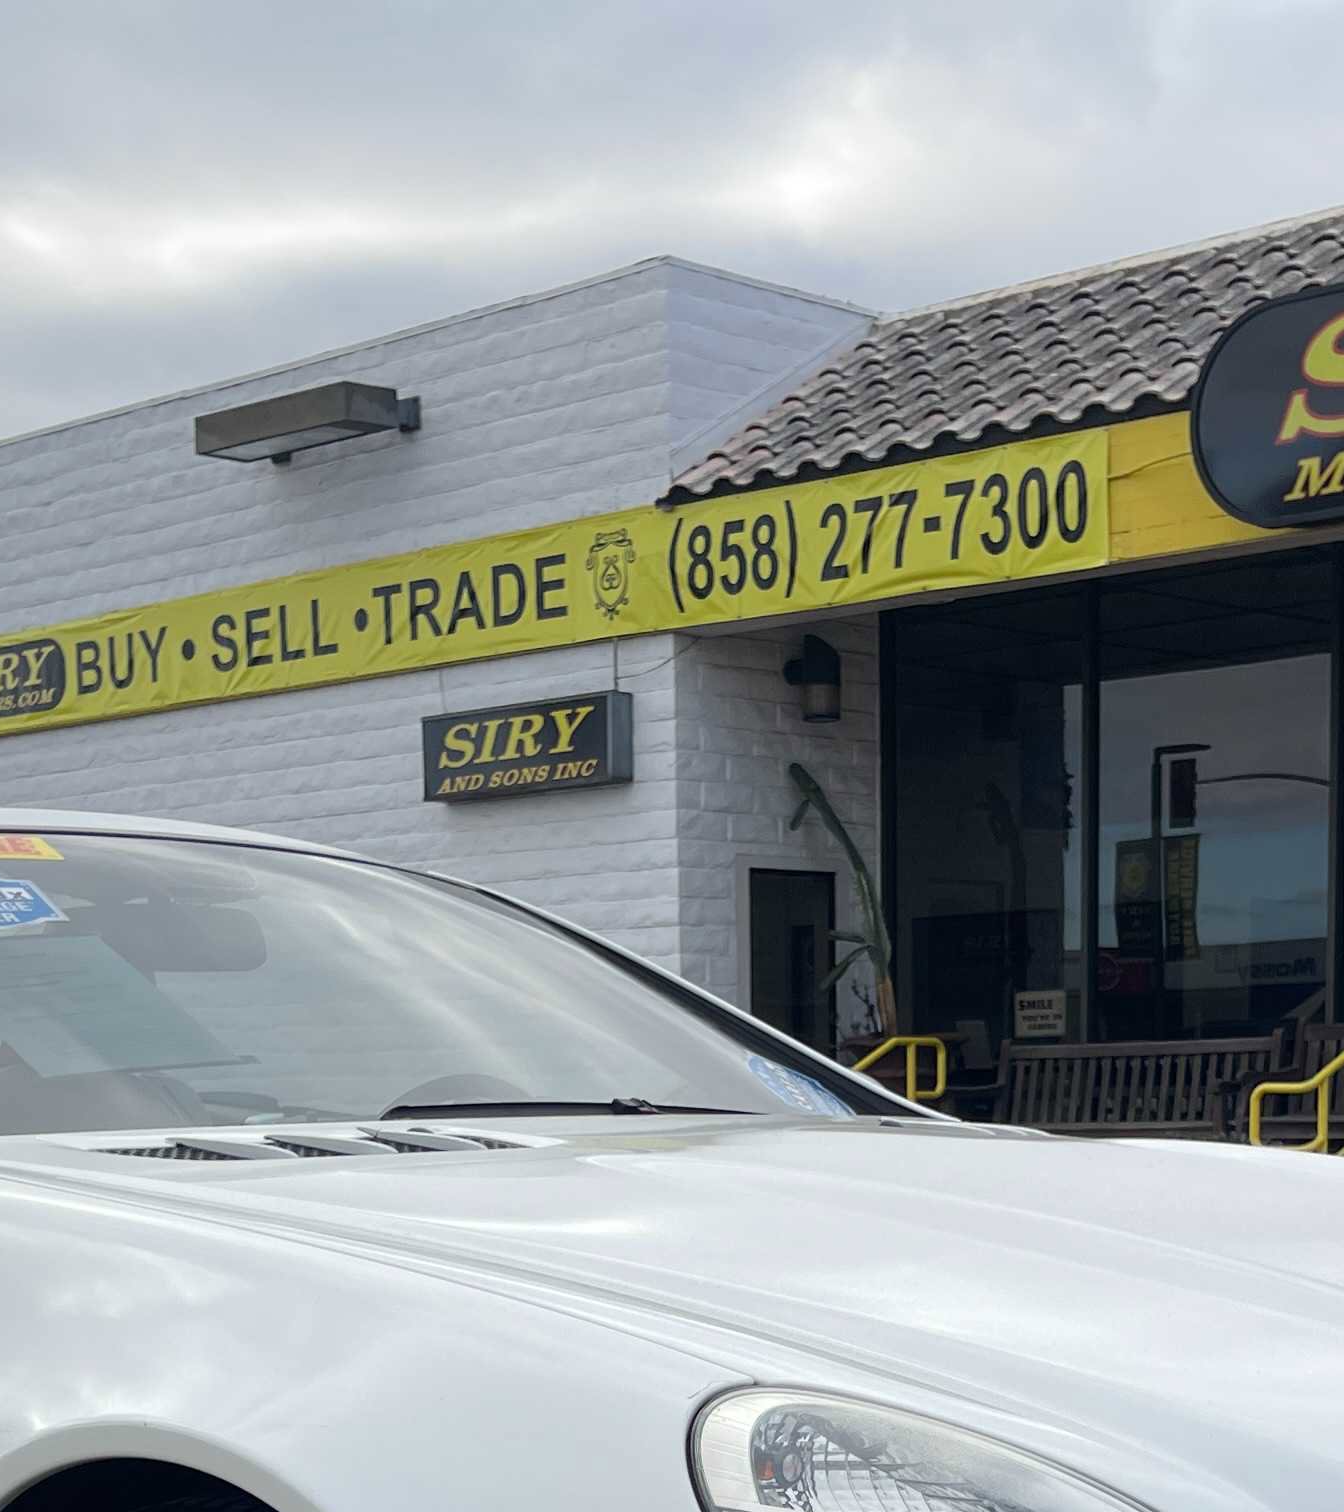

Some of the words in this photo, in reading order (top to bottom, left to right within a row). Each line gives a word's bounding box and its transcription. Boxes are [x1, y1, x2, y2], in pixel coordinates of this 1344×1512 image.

[669, 500, 797, 613] (858)
[820, 460, 1087, 581] 277-7300
[76, 626, 168, 695] BUY
[211, 599, 338, 672] SELL
[371, 553, 568, 645] TRADE
[436, 774, 485, 795] AND
[489, 765, 550, 788] SONS
[553, 759, 598, 780] INC
[439, 706, 595, 769] SIRY
